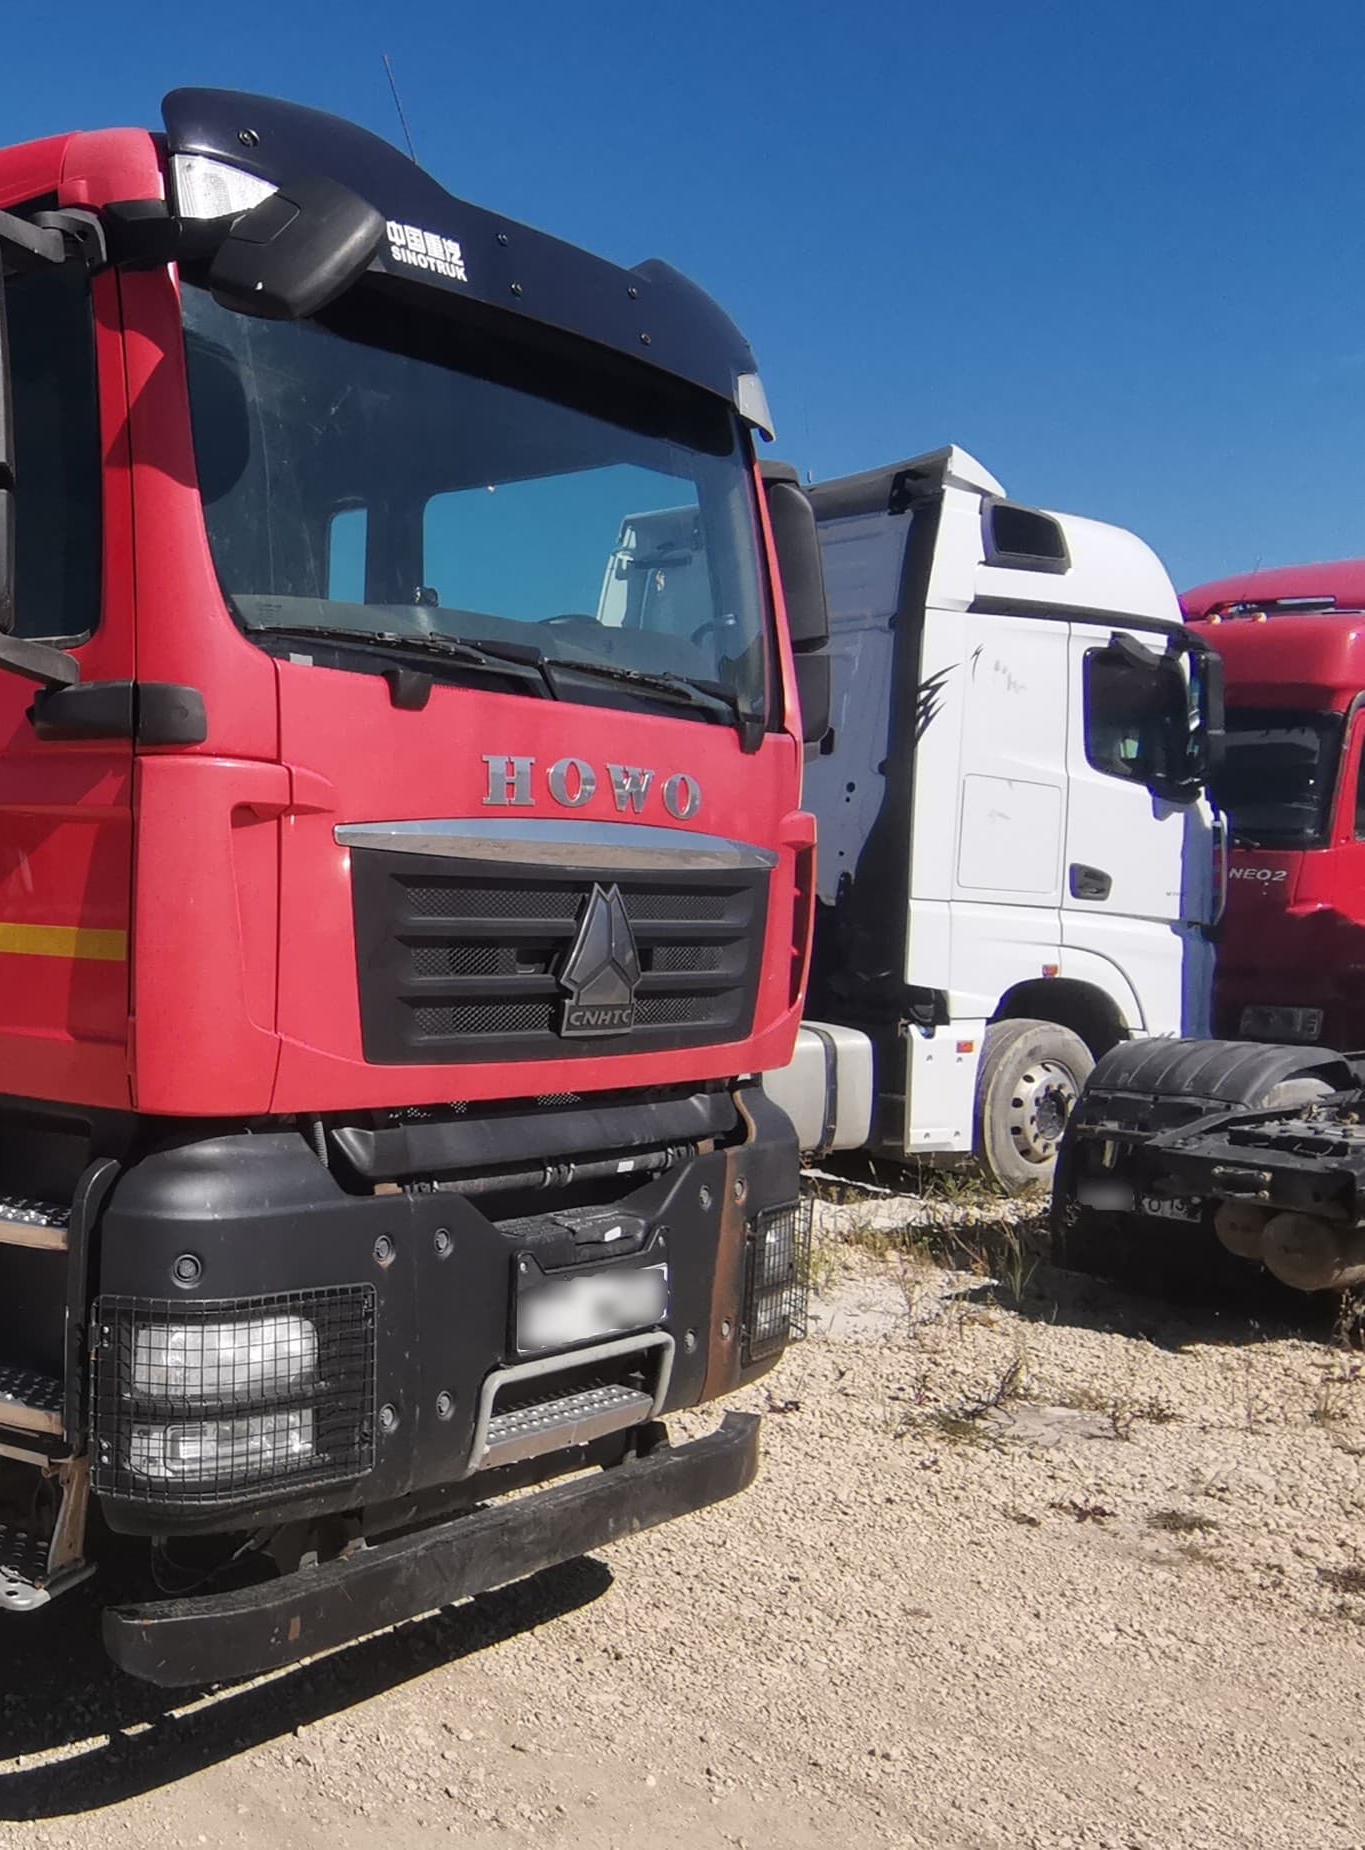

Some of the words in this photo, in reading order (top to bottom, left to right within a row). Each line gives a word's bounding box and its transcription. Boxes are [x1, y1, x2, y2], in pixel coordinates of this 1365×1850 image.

[386, 221, 464, 266] 中国重汽
[391, 245, 468, 282] SINOTRUK
[482, 755, 702, 820] HOWO
[1229, 868, 1287, 882] NEO2
[569, 1009, 631, 1026] CNHTC
